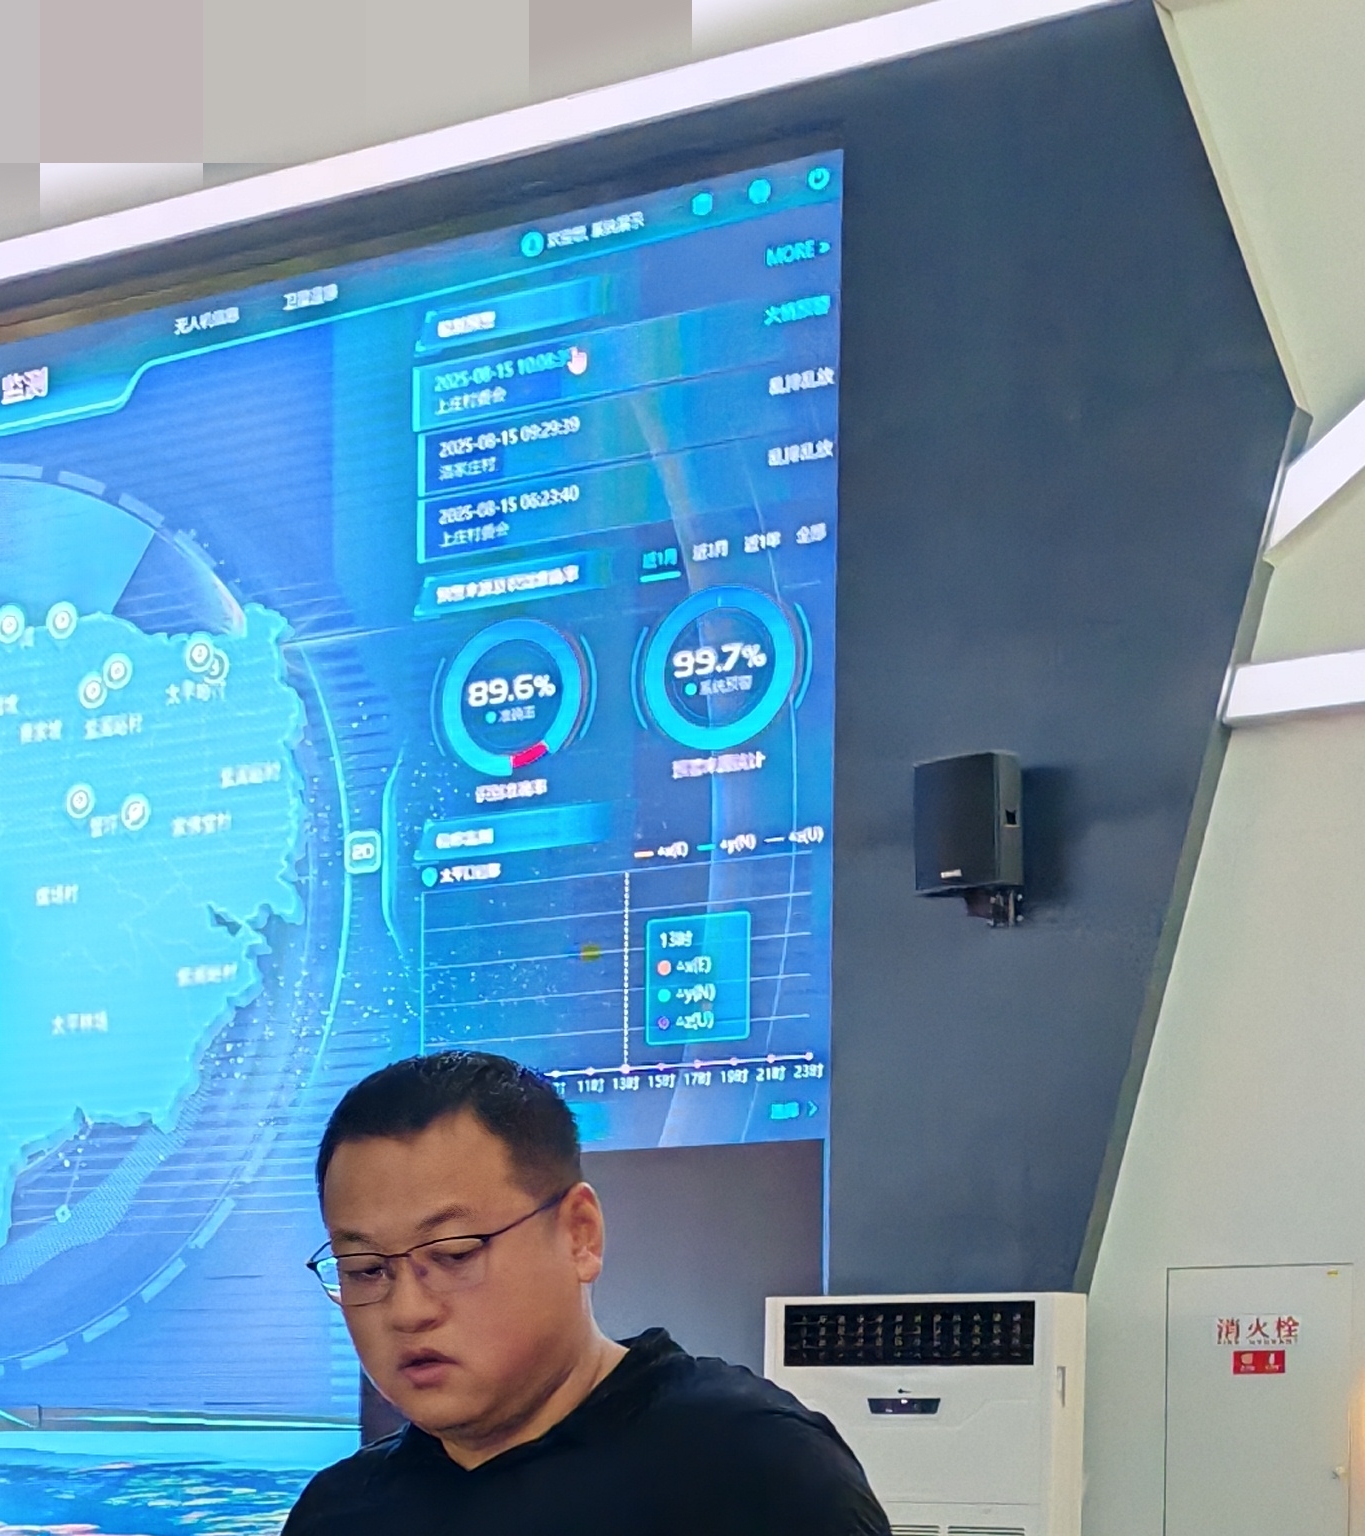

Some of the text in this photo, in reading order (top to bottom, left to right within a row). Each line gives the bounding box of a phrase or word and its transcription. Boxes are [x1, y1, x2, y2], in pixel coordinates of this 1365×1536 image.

[766, 240, 816, 268] MORE
[439, 428, 518, 458] 2025-08-15
[439, 496, 518, 525] 2025-08-15
[672, 642, 767, 678] 99.7%
[468, 674, 556, 707] 89.6%
[1217, 1315, 1300, 1338] 消火栓
